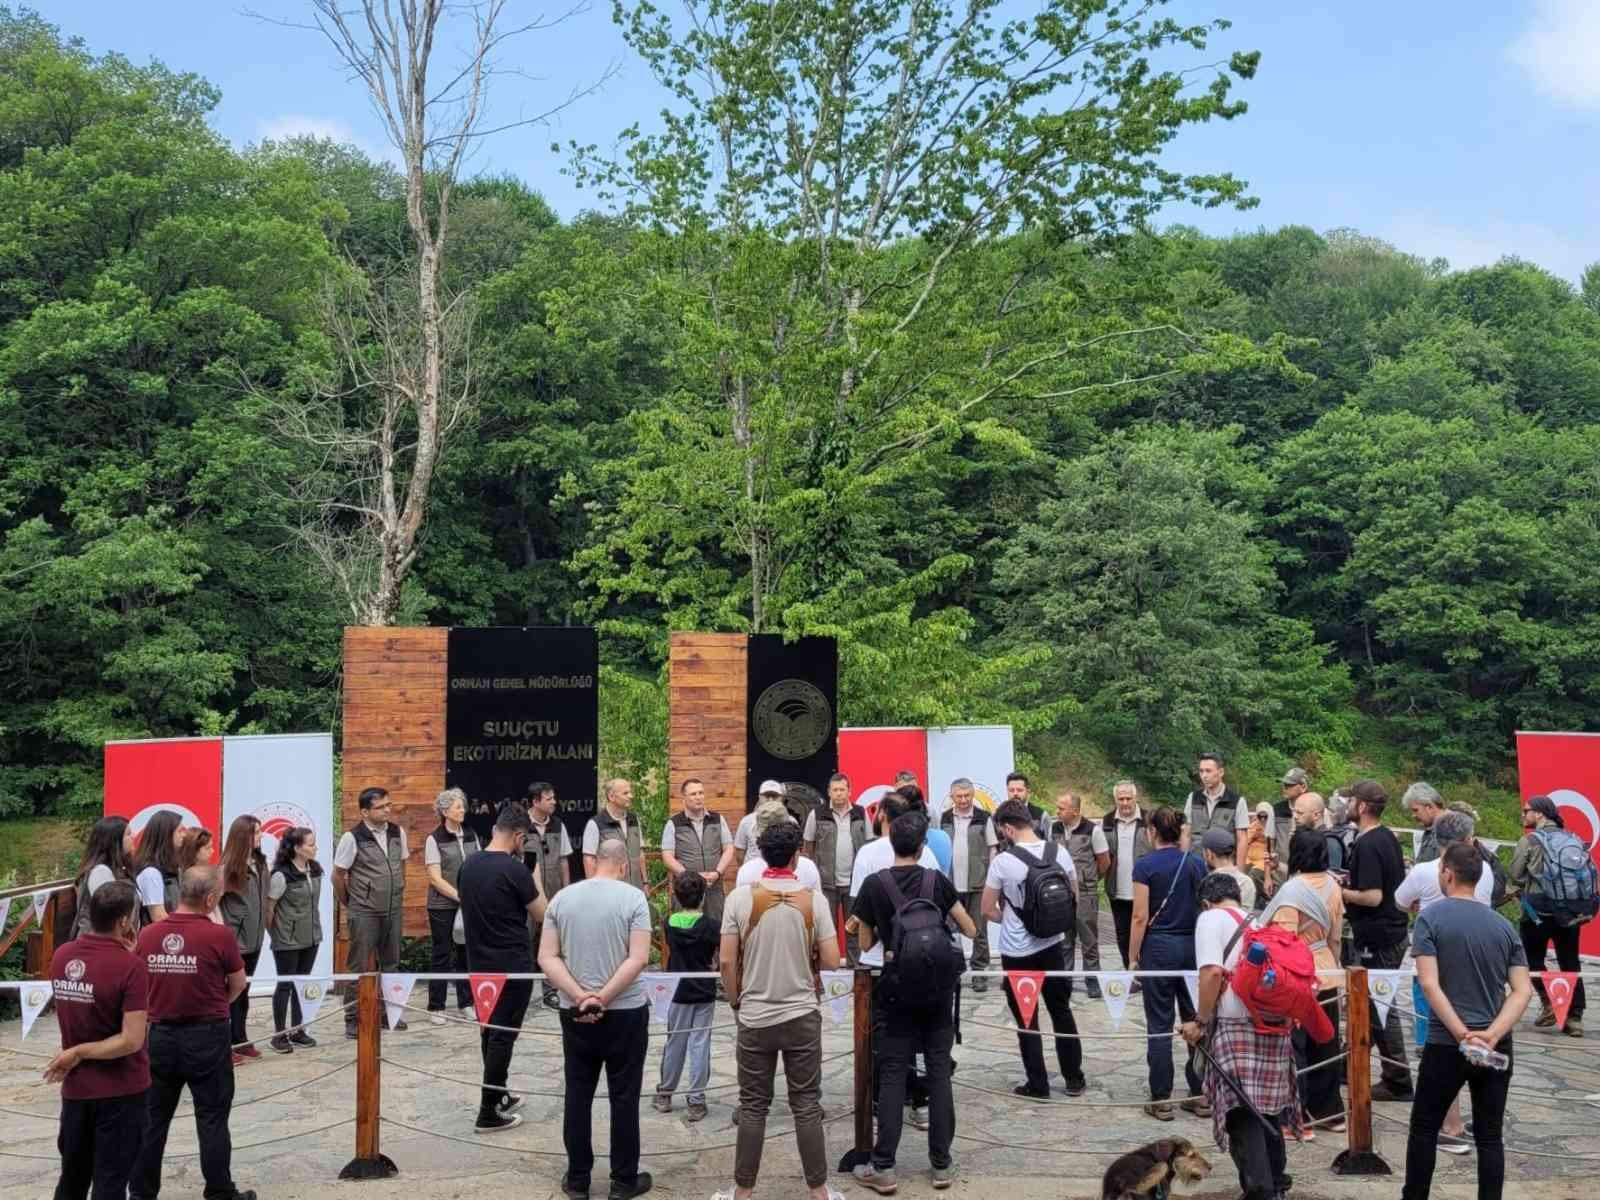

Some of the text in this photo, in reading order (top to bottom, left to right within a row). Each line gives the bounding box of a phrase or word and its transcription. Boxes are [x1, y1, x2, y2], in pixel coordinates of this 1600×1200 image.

[451, 677, 490, 689] ORMAN
[493, 677, 527, 689] GENEL
[483, 720, 559, 739] SUUÇTU
[453, 742, 593, 761] EKOTURİZM ALANI
[560, 799, 594, 812] YOLU
[147, 954, 197, 965] ORMAN
[53, 979, 94, 994] ORMAN
